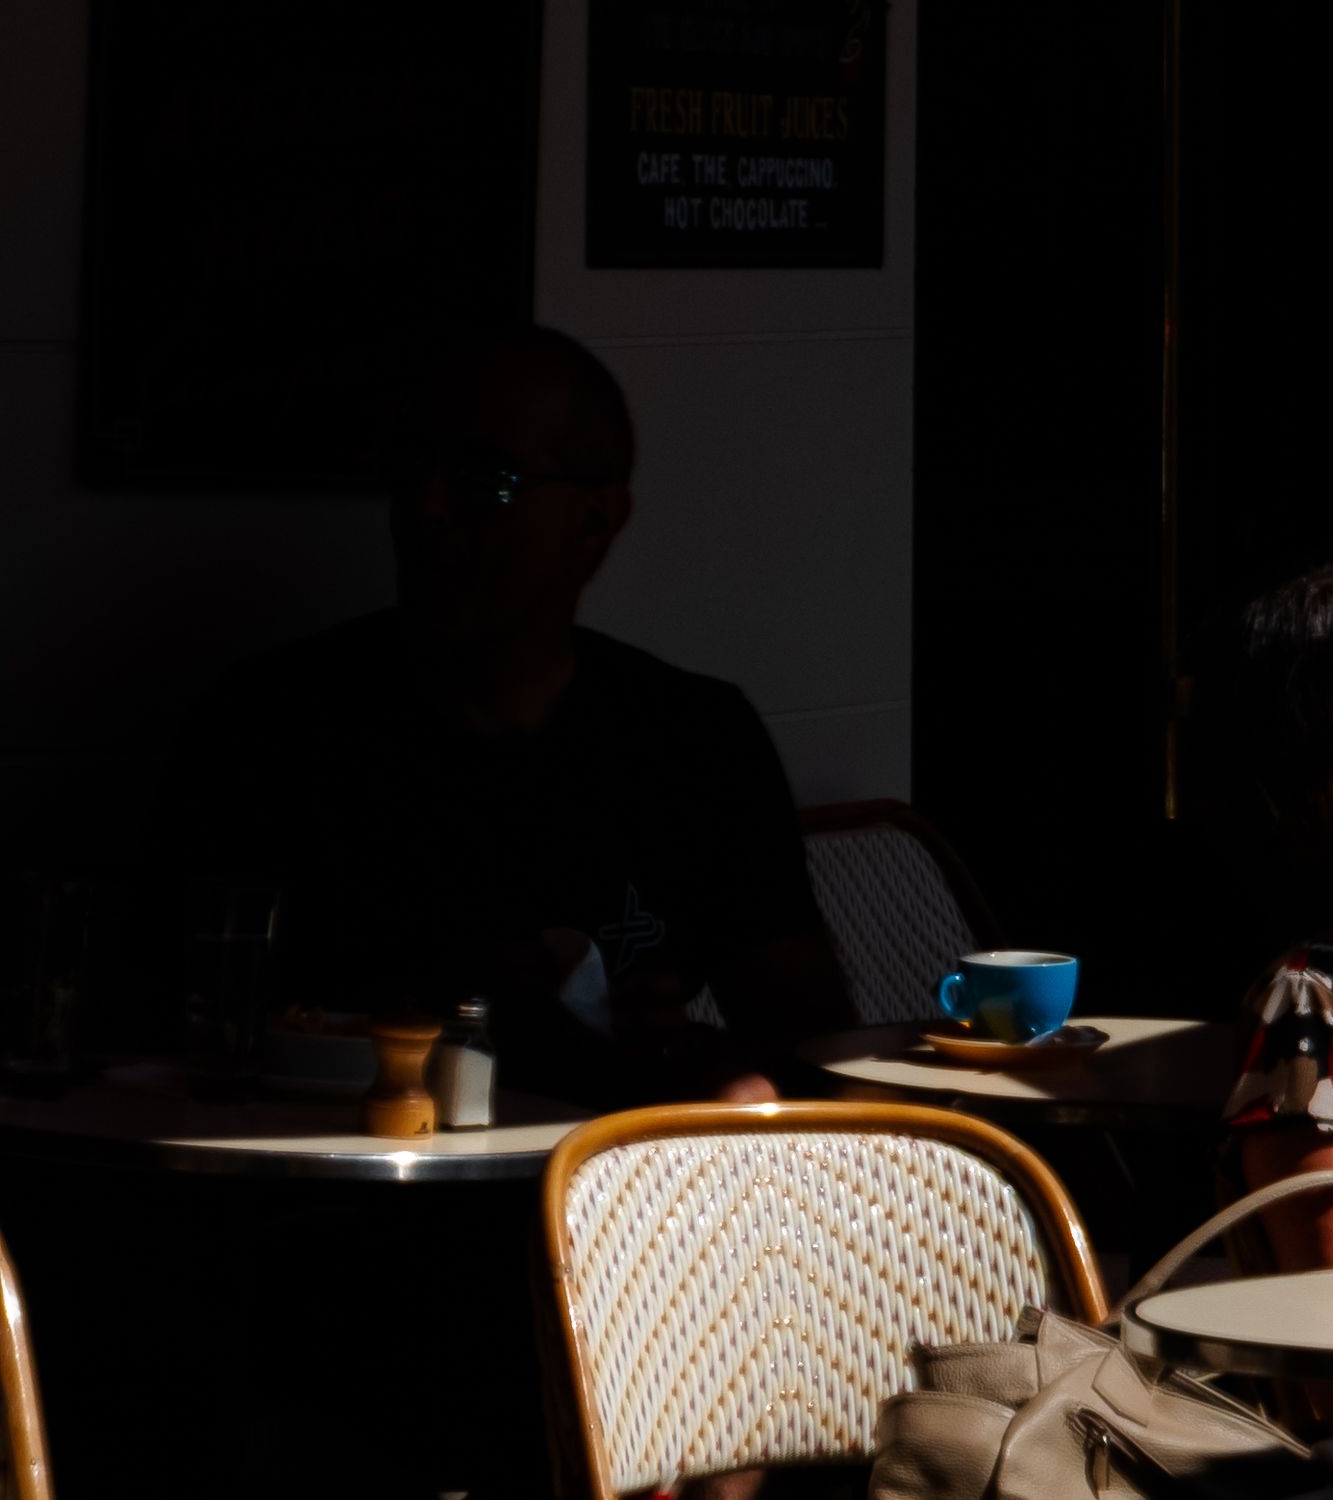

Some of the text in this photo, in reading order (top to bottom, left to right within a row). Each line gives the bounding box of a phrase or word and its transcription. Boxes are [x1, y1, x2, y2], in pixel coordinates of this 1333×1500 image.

[629, 87, 850, 144] FRESH FRUIT JUICES
[663, 197, 703, 229] HOT
[709, 198, 809, 232] CHOCOLATE
